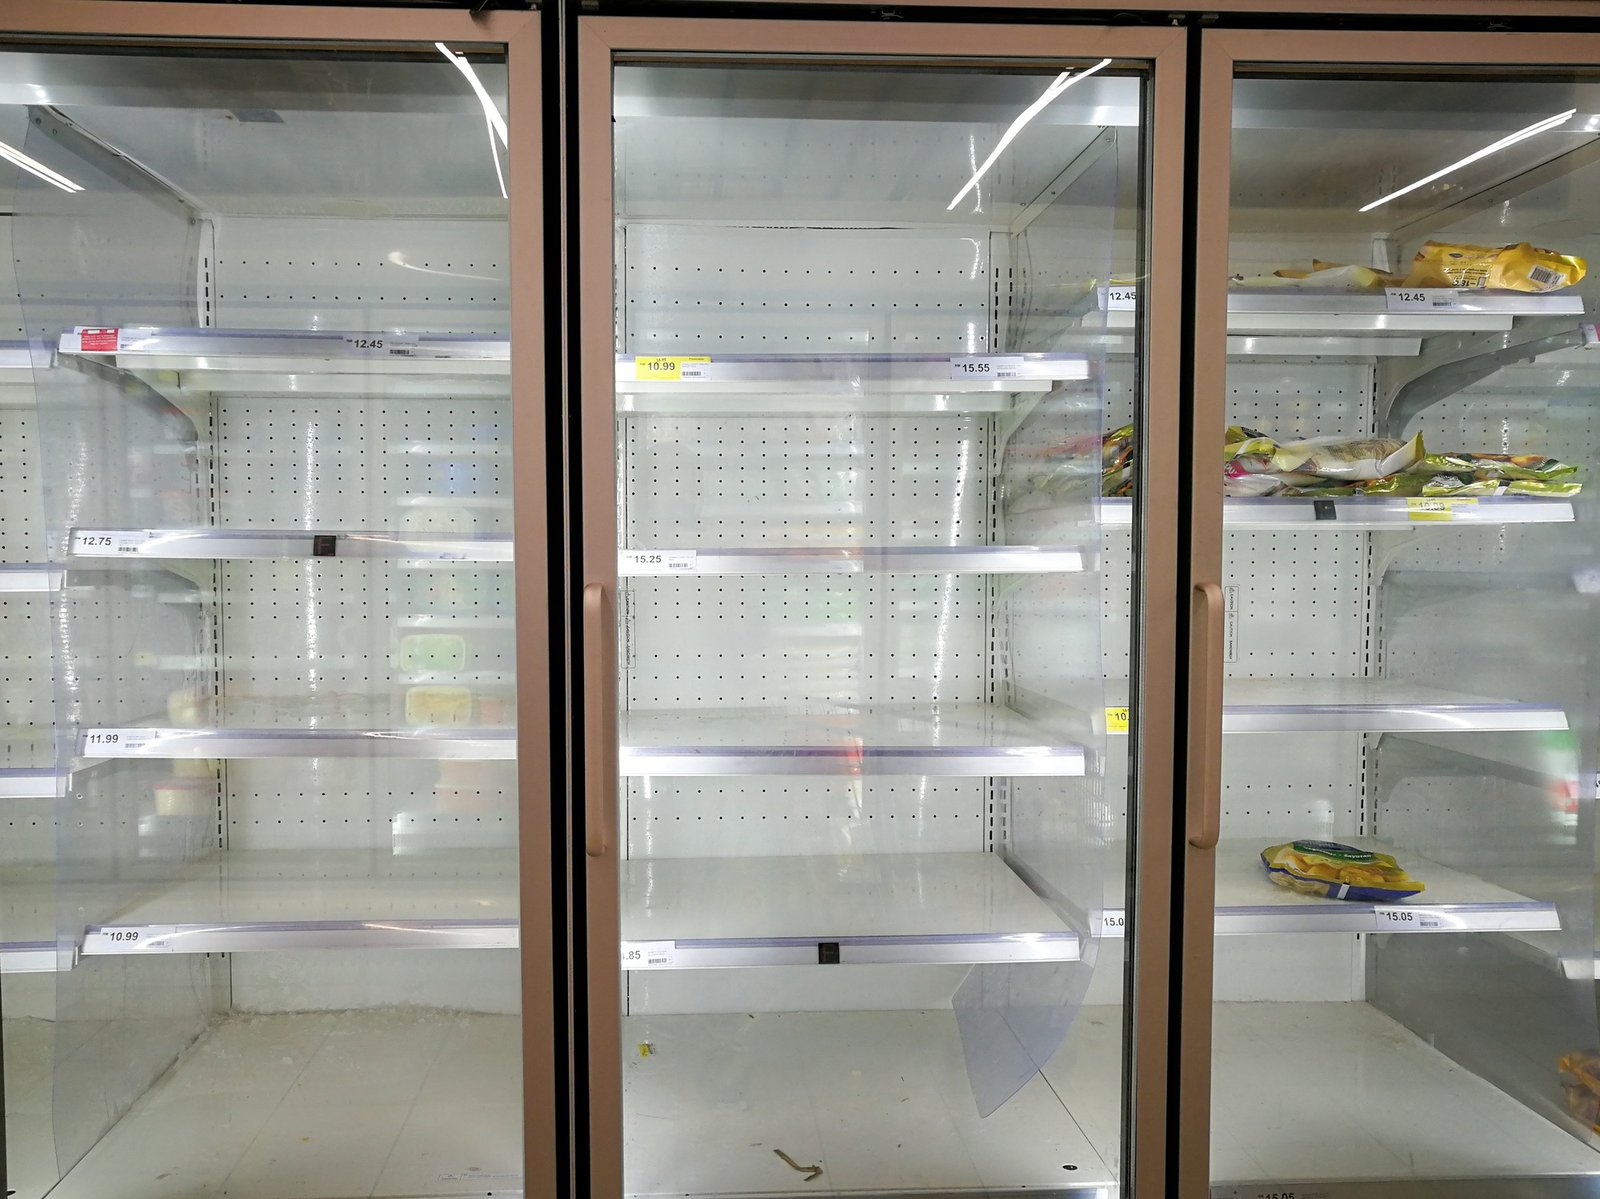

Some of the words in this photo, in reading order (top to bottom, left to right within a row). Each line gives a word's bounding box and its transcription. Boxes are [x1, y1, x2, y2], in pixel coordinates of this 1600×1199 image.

[1109, 291, 1136, 301] 12.45
[1397, 292, 1426, 302] 12.45
[353, 339, 383, 349] 12.45
[647, 362, 676, 371] 10.99
[962, 363, 991, 373] 15.55
[82, 536, 112, 546] 12.75
[634, 555, 662, 564] 15.25
[1114, 711, 1129, 721] 10.
[89, 734, 119, 744] 11.99
[1103, 917, 1125, 927] 15.0
[1385, 912, 1414, 922] 15.05
[109, 931, 139, 942] 10.99
